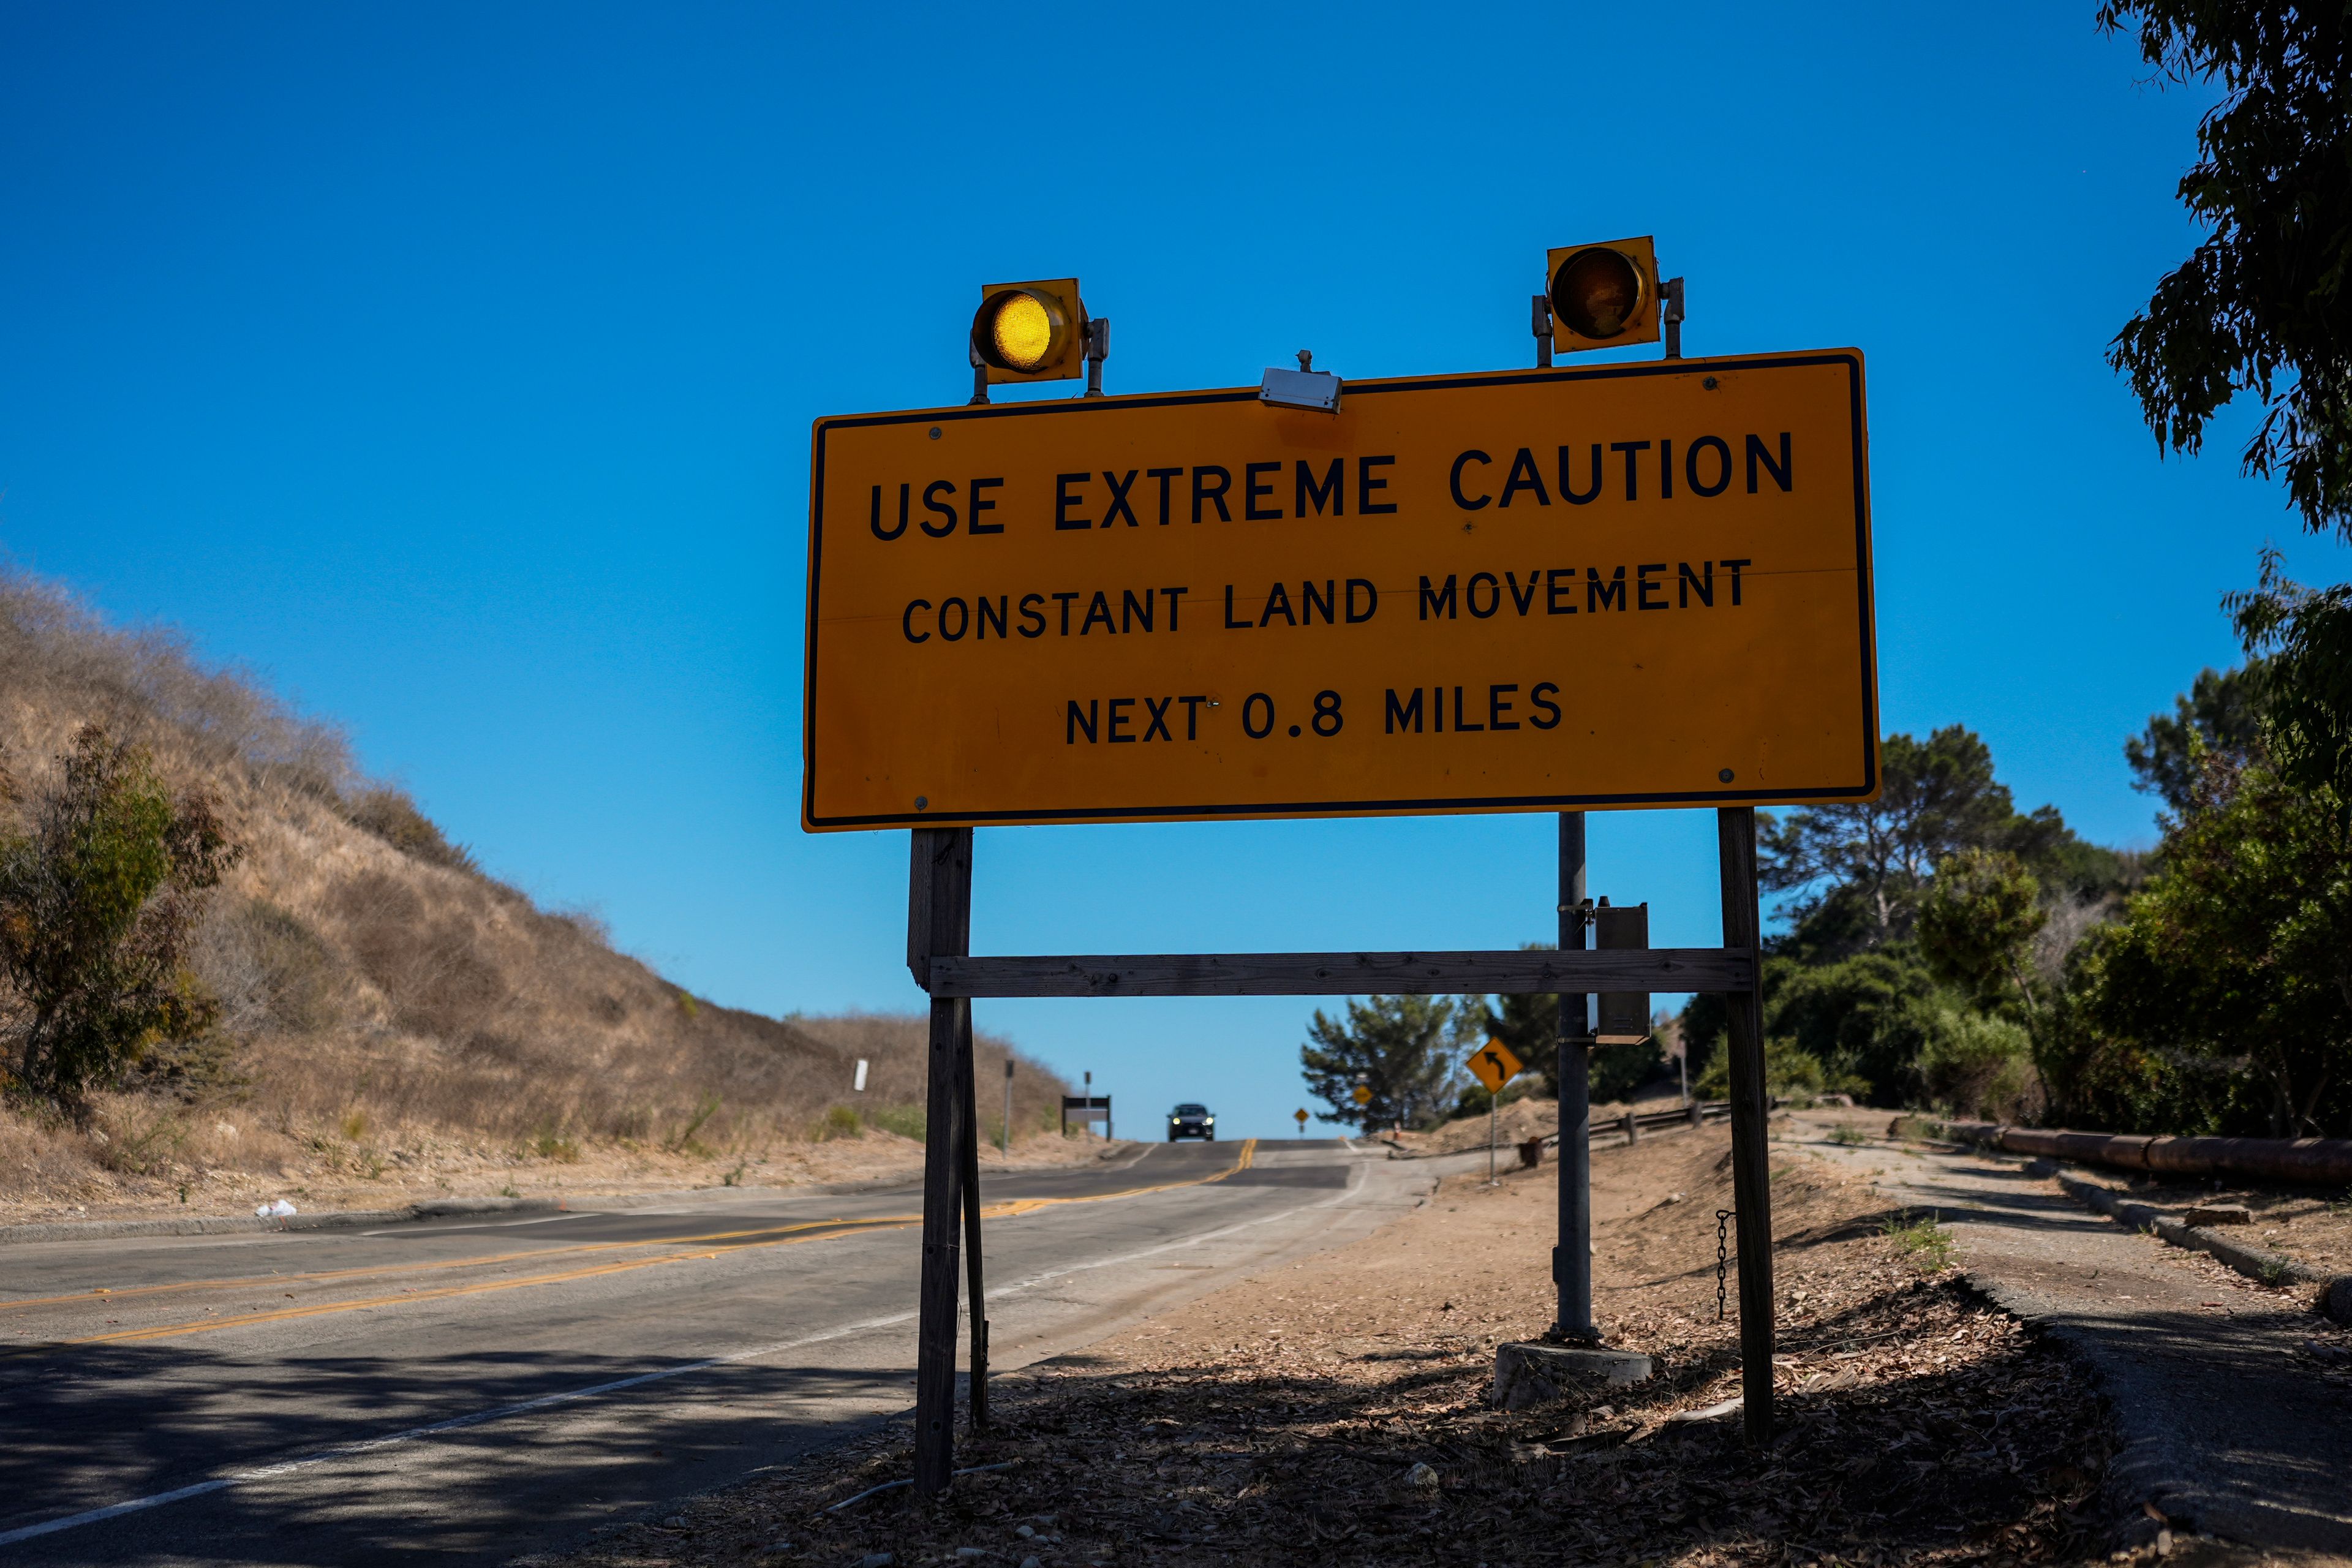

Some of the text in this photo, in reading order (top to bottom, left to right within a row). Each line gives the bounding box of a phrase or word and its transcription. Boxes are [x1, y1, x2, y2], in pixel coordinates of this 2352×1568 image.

[870, 431, 1793, 541] USE EXTREME CAUTION
[902, 559, 1752, 644] CONSTANT LAND MOVEMENT
[1066, 682, 1562, 745] NEXT 0.8 MILES
